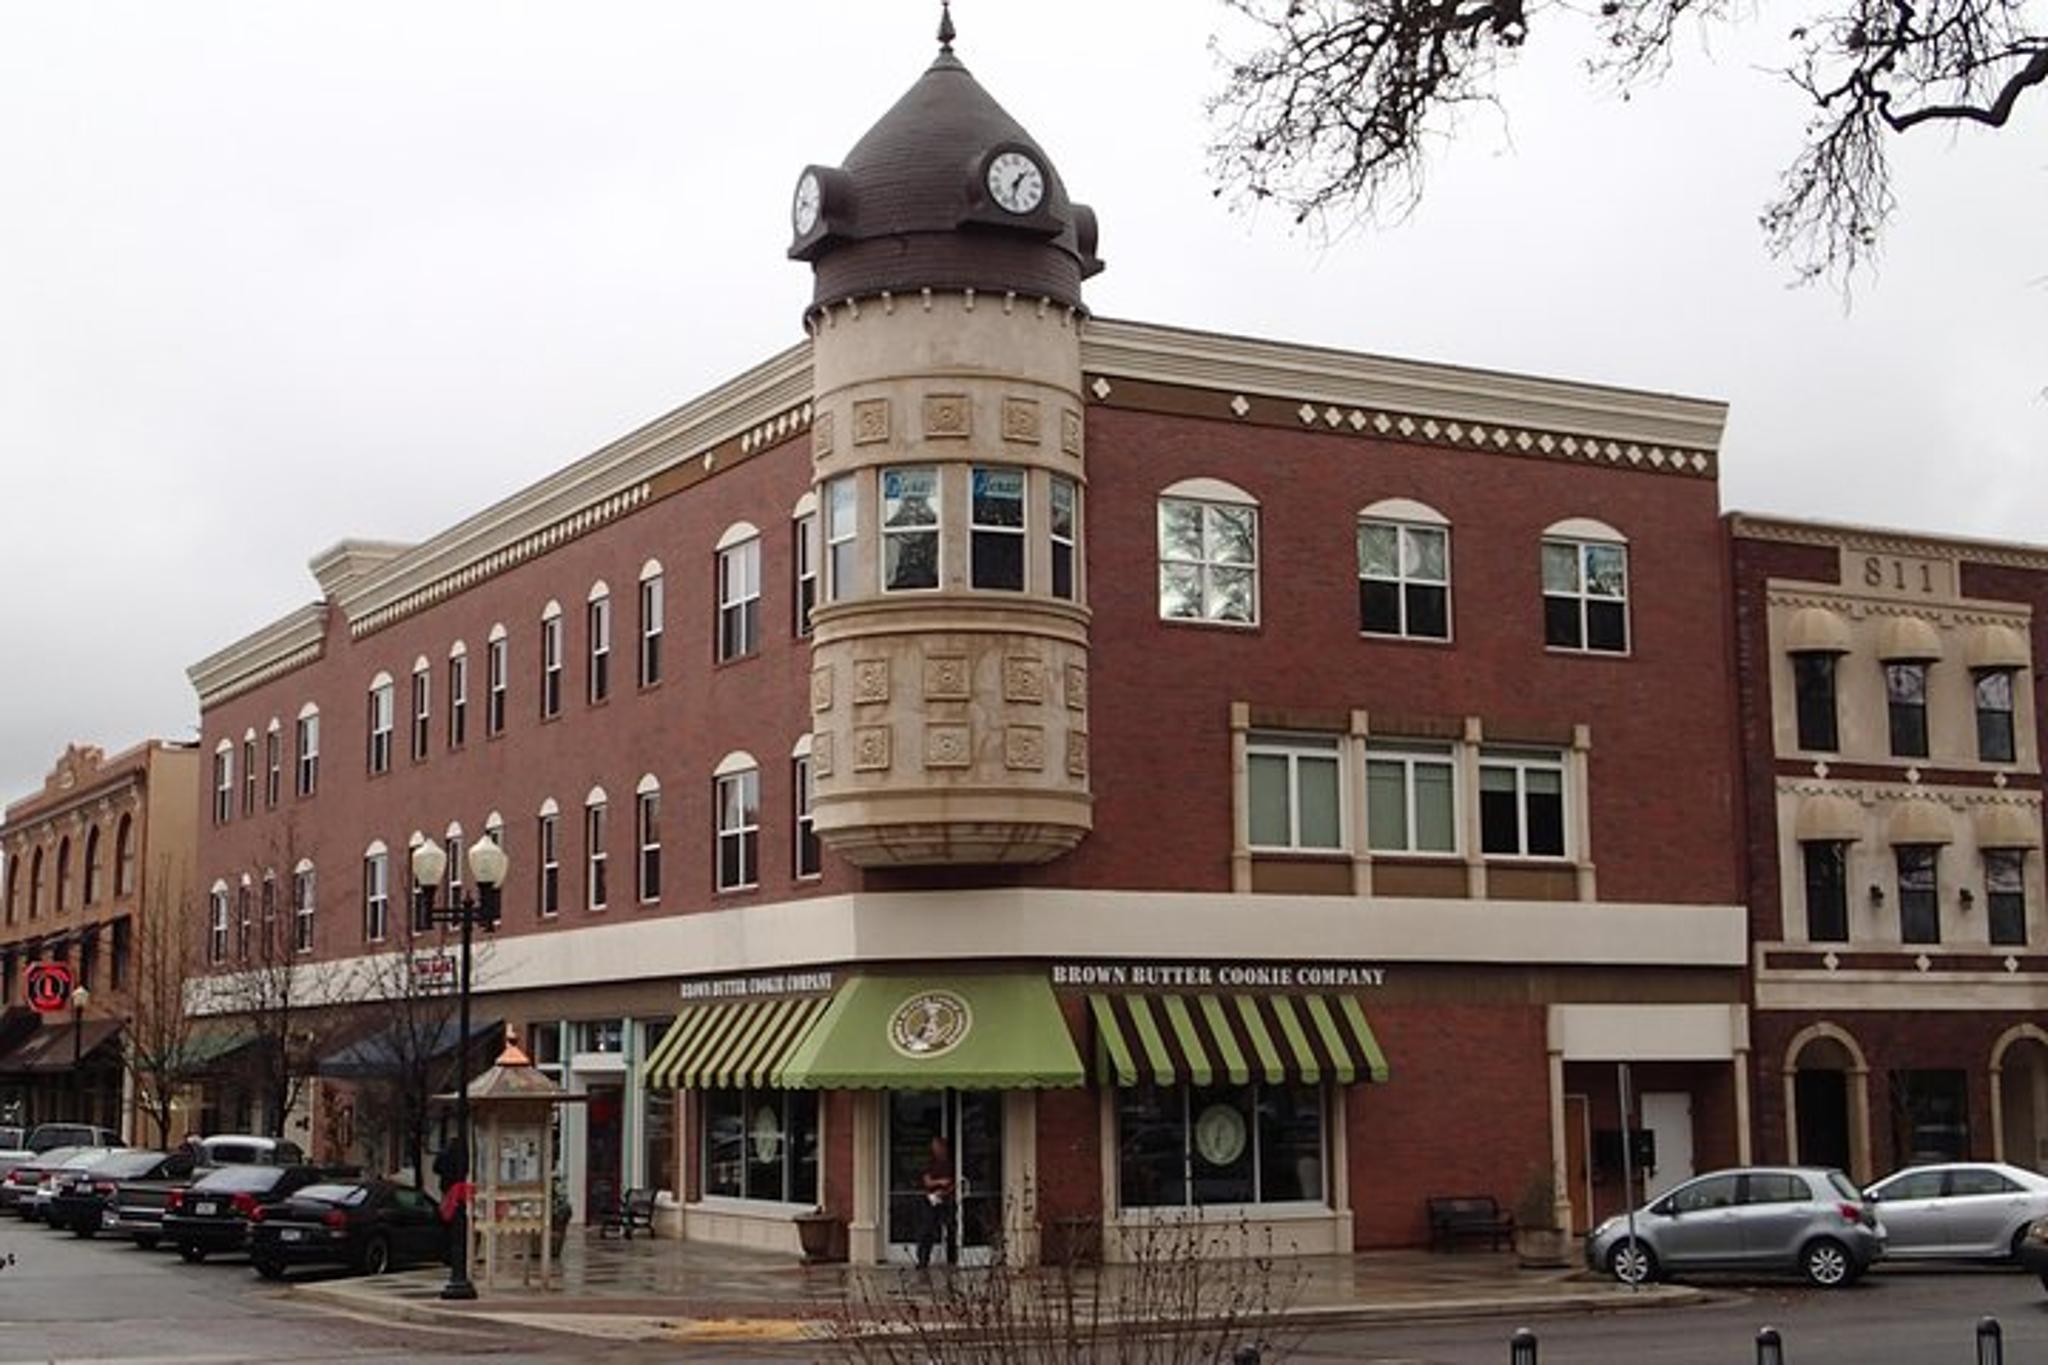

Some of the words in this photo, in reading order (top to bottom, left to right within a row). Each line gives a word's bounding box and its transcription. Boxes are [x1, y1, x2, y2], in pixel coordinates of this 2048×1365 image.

[1865, 556, 1933, 592] 811
[1052, 965, 1127, 984] BROWN
[1131, 965, 1213, 985] BUTTER
[1218, 966, 1293, 985] COOKIE
[1296, 966, 1386, 986] COMPANY
